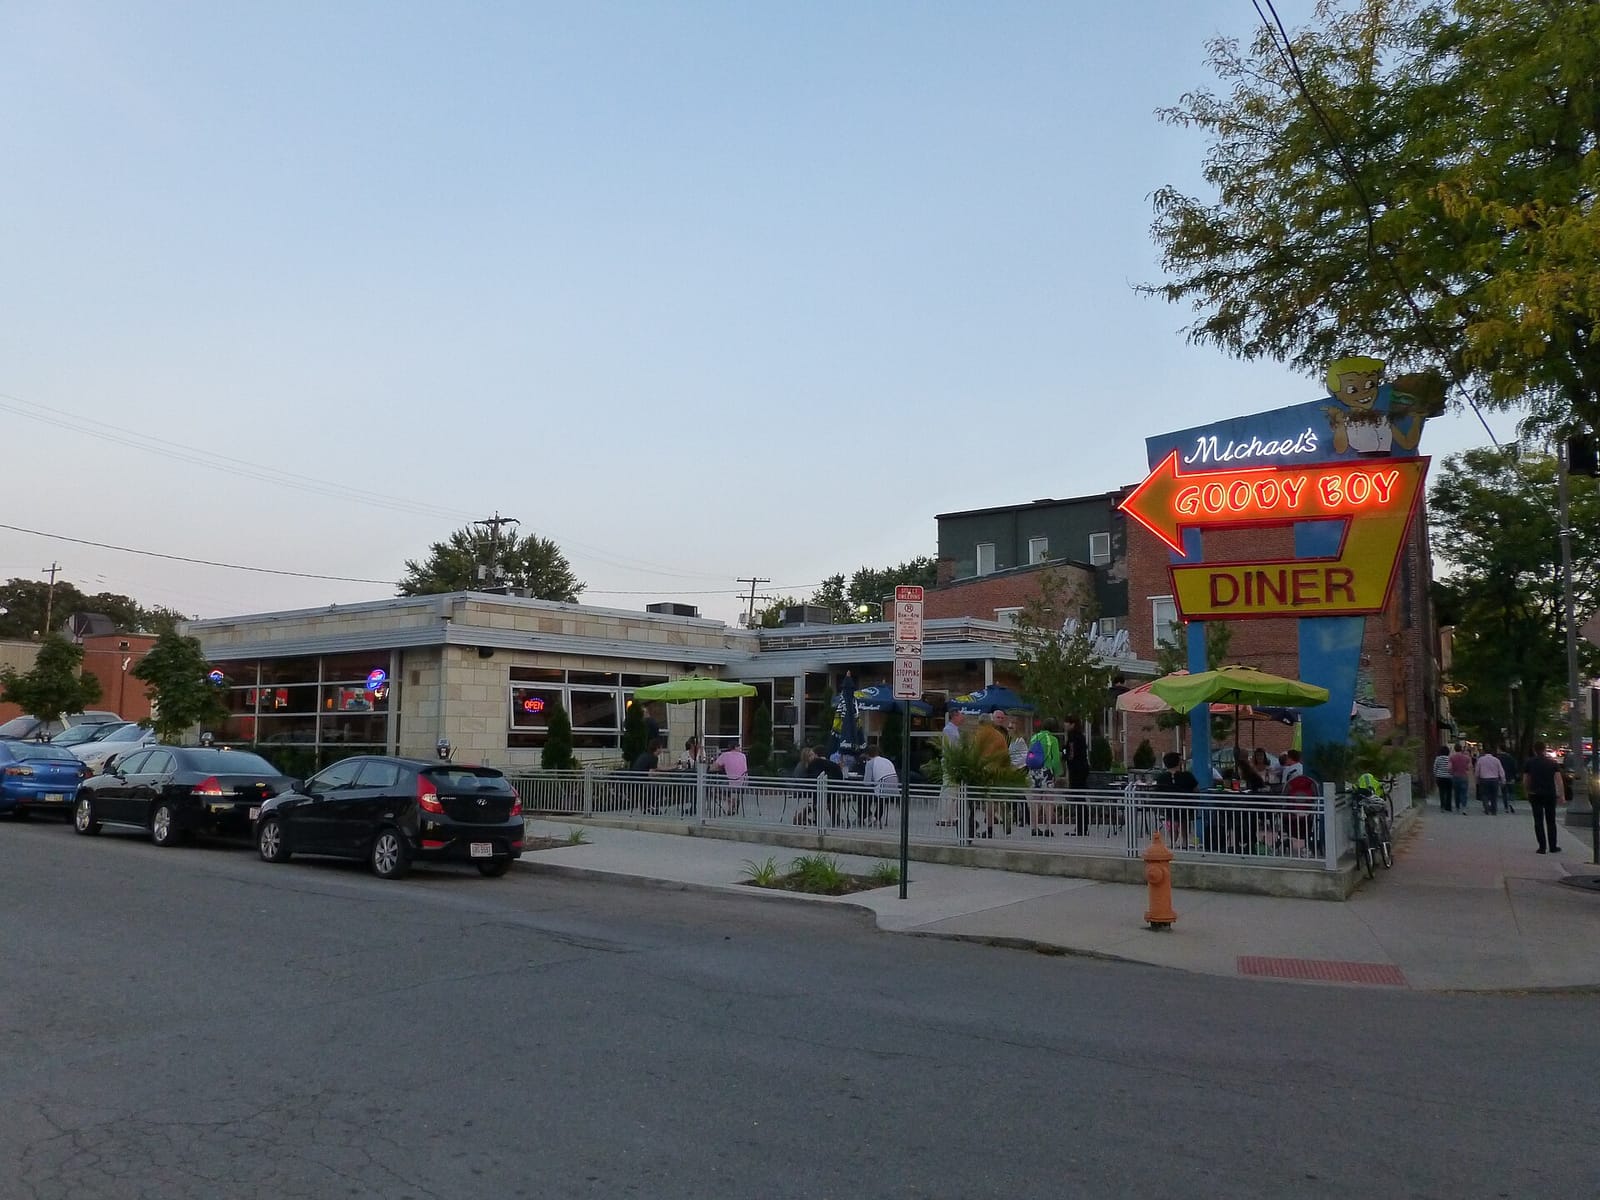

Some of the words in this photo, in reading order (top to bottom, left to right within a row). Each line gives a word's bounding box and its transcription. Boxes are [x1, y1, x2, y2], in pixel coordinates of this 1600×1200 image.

[1184, 427, 1319, 464] Michael's
[1174, 476, 1306, 515] GOODY
[1318, 470, 1400, 508] BOY
[1208, 567, 1357, 609] DINER
[896, 669, 920, 677] STOPPING
[903, 661, 913, 669] NO
[524, 700, 545, 710] OPEN
